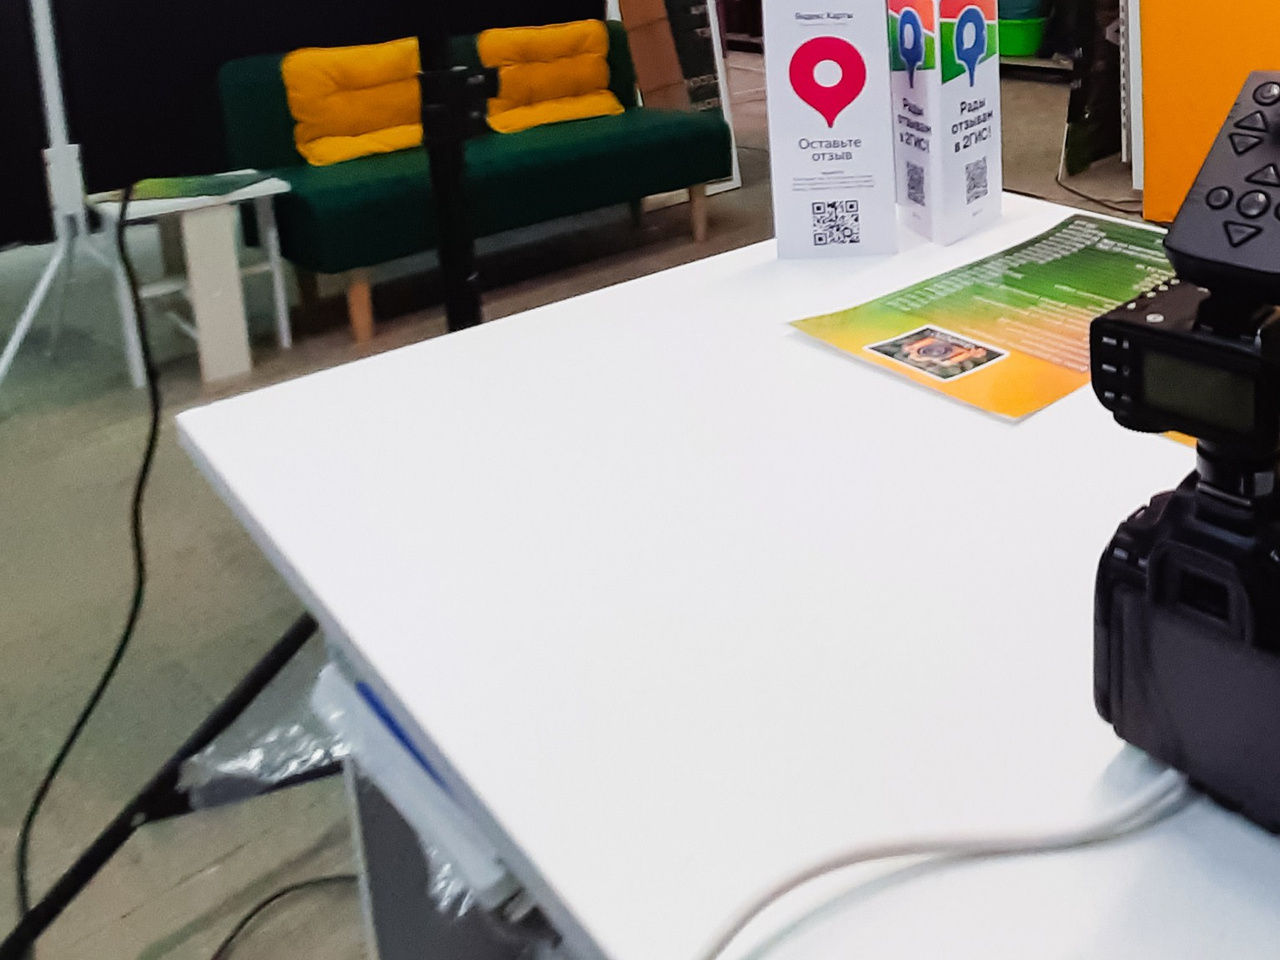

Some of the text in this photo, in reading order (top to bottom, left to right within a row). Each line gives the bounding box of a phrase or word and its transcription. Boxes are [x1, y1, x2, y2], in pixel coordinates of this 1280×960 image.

[960, 99, 985, 115] Рады
[951, 111, 993, 135] отзывам
[799, 138, 862, 149] Оставьте
[955, 126, 991, 153] в 2ГИС!
[812, 152, 853, 161] отзыв
